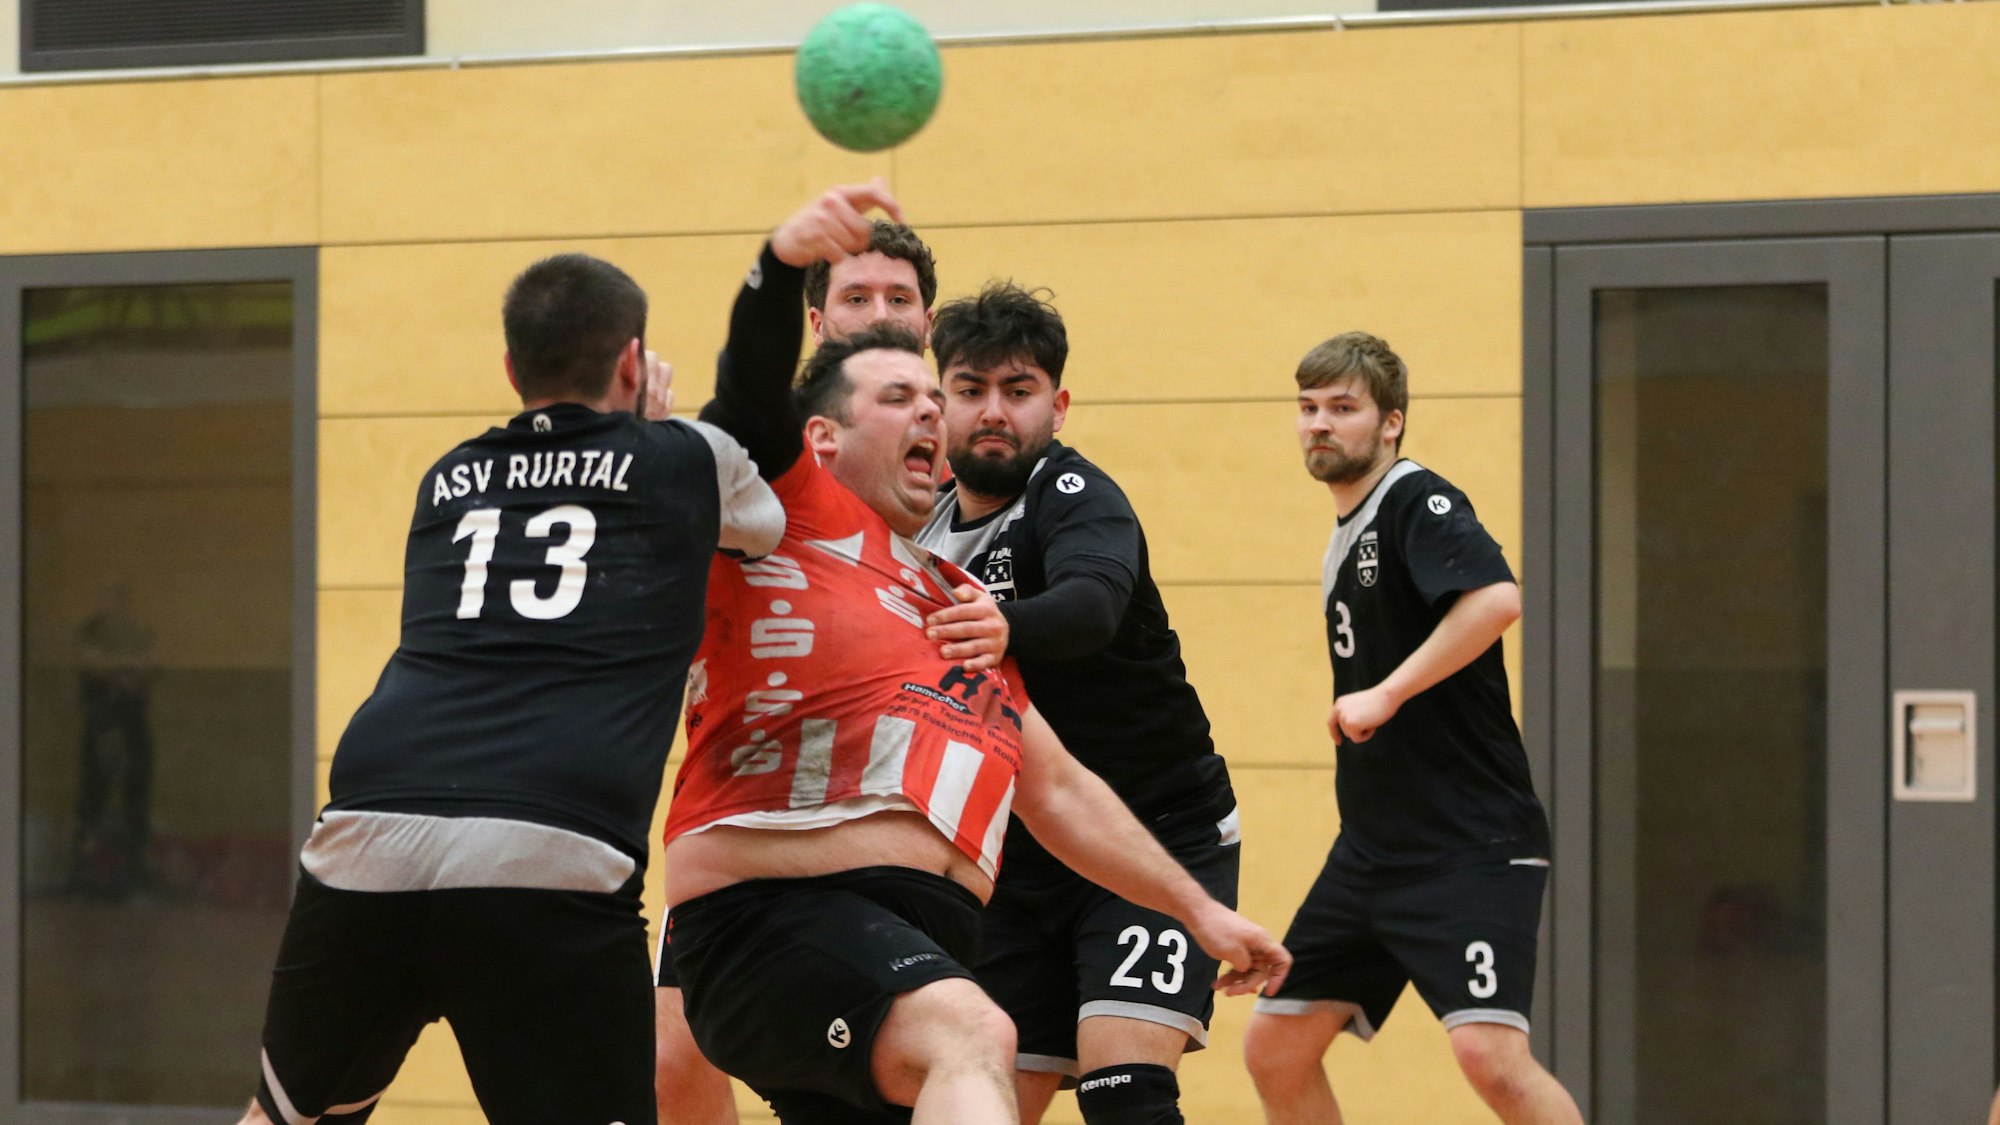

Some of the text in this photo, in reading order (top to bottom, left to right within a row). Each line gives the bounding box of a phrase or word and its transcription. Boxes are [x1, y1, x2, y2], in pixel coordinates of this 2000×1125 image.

[433, 450, 634, 507] ASV RURTAL
[1059, 474, 1082, 492] K
[1430, 497, 1448, 512] K
[452, 505, 597, 620] 13
[1334, 601, 1355, 658] 3
[922, 711, 982, 745] Euskirchen
[1109, 925, 1188, 995] 23
[1465, 940, 1498, 999] 3
